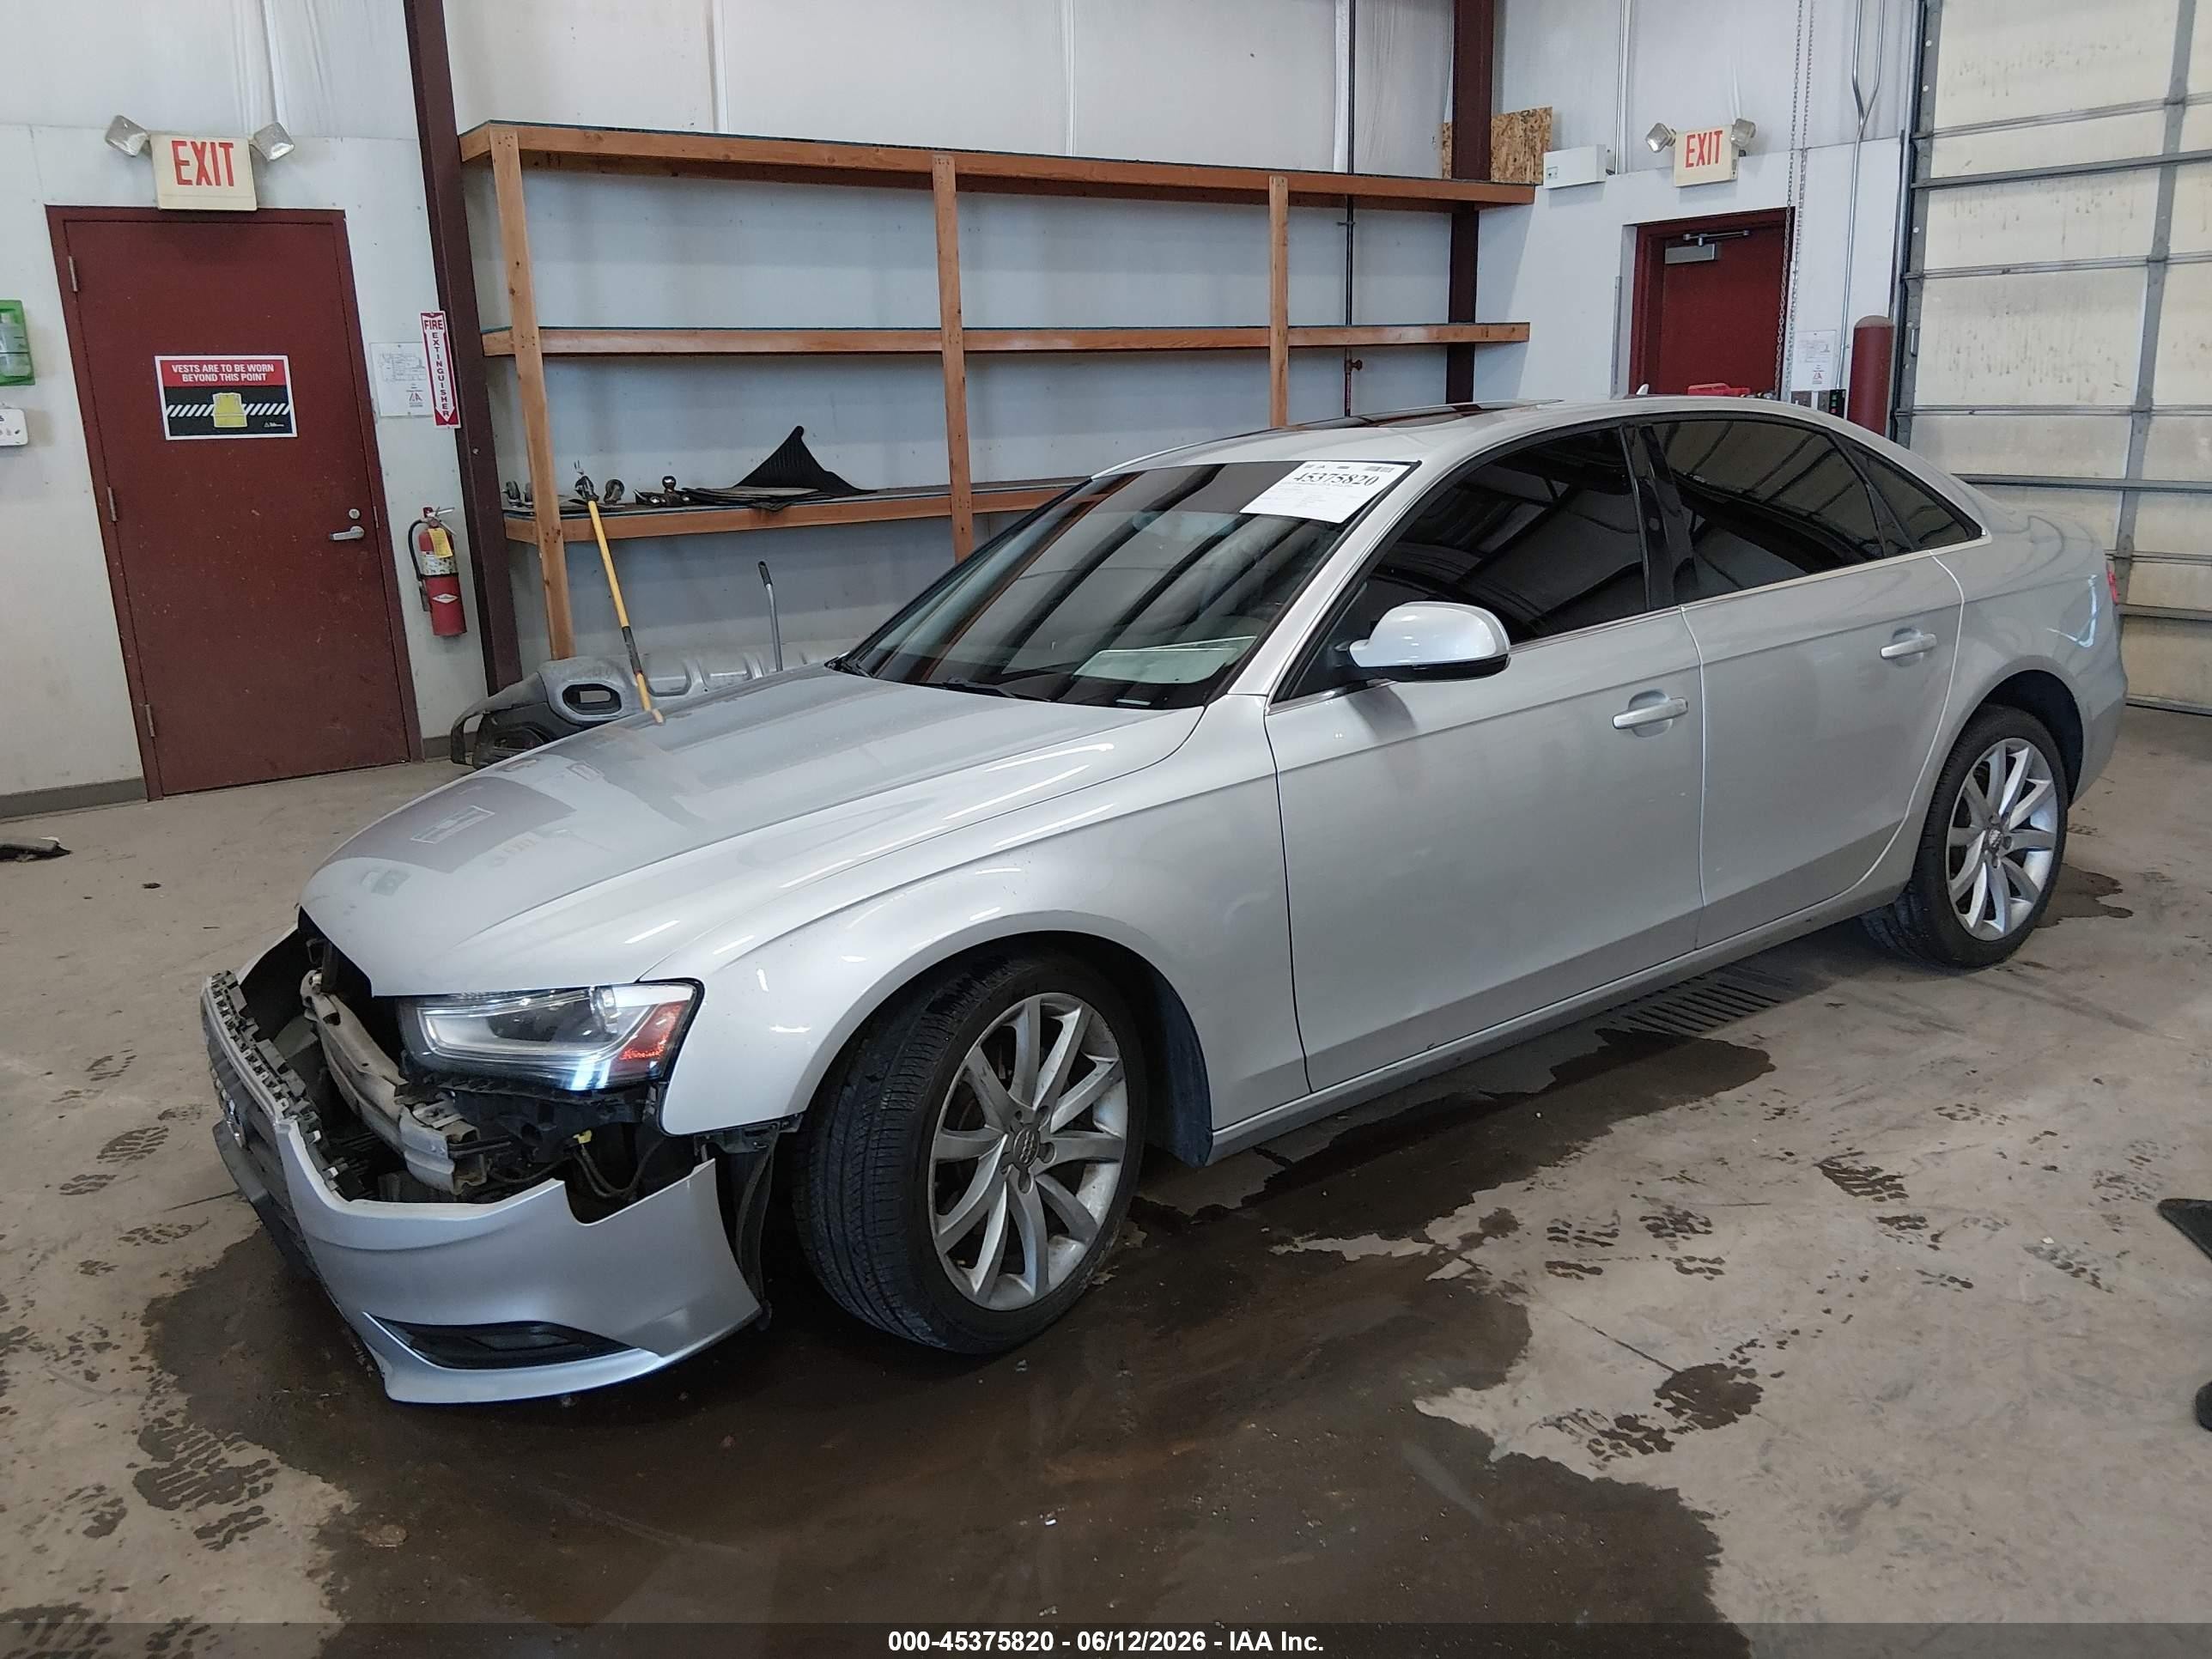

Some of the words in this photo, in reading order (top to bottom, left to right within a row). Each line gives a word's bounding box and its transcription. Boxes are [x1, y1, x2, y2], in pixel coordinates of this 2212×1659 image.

[1686, 130, 1723, 168] EXIT
[172, 141, 234, 186] EXIT
[424, 320, 443, 331] FIRE
[172, 364, 200, 373] VESTS
[202, 364, 219, 373] ARE
[220, 364, 233, 373] TO
[234, 363, 246, 373] BE
[245, 363, 275, 373] WORN
[432, 332, 450, 416] EXTINGUISHER
[182, 374, 218, 382] BEYOND
[219, 373, 240, 382] THIS
[241, 373, 267, 381] POINT
[1293, 472, 1379, 486] 45375820
